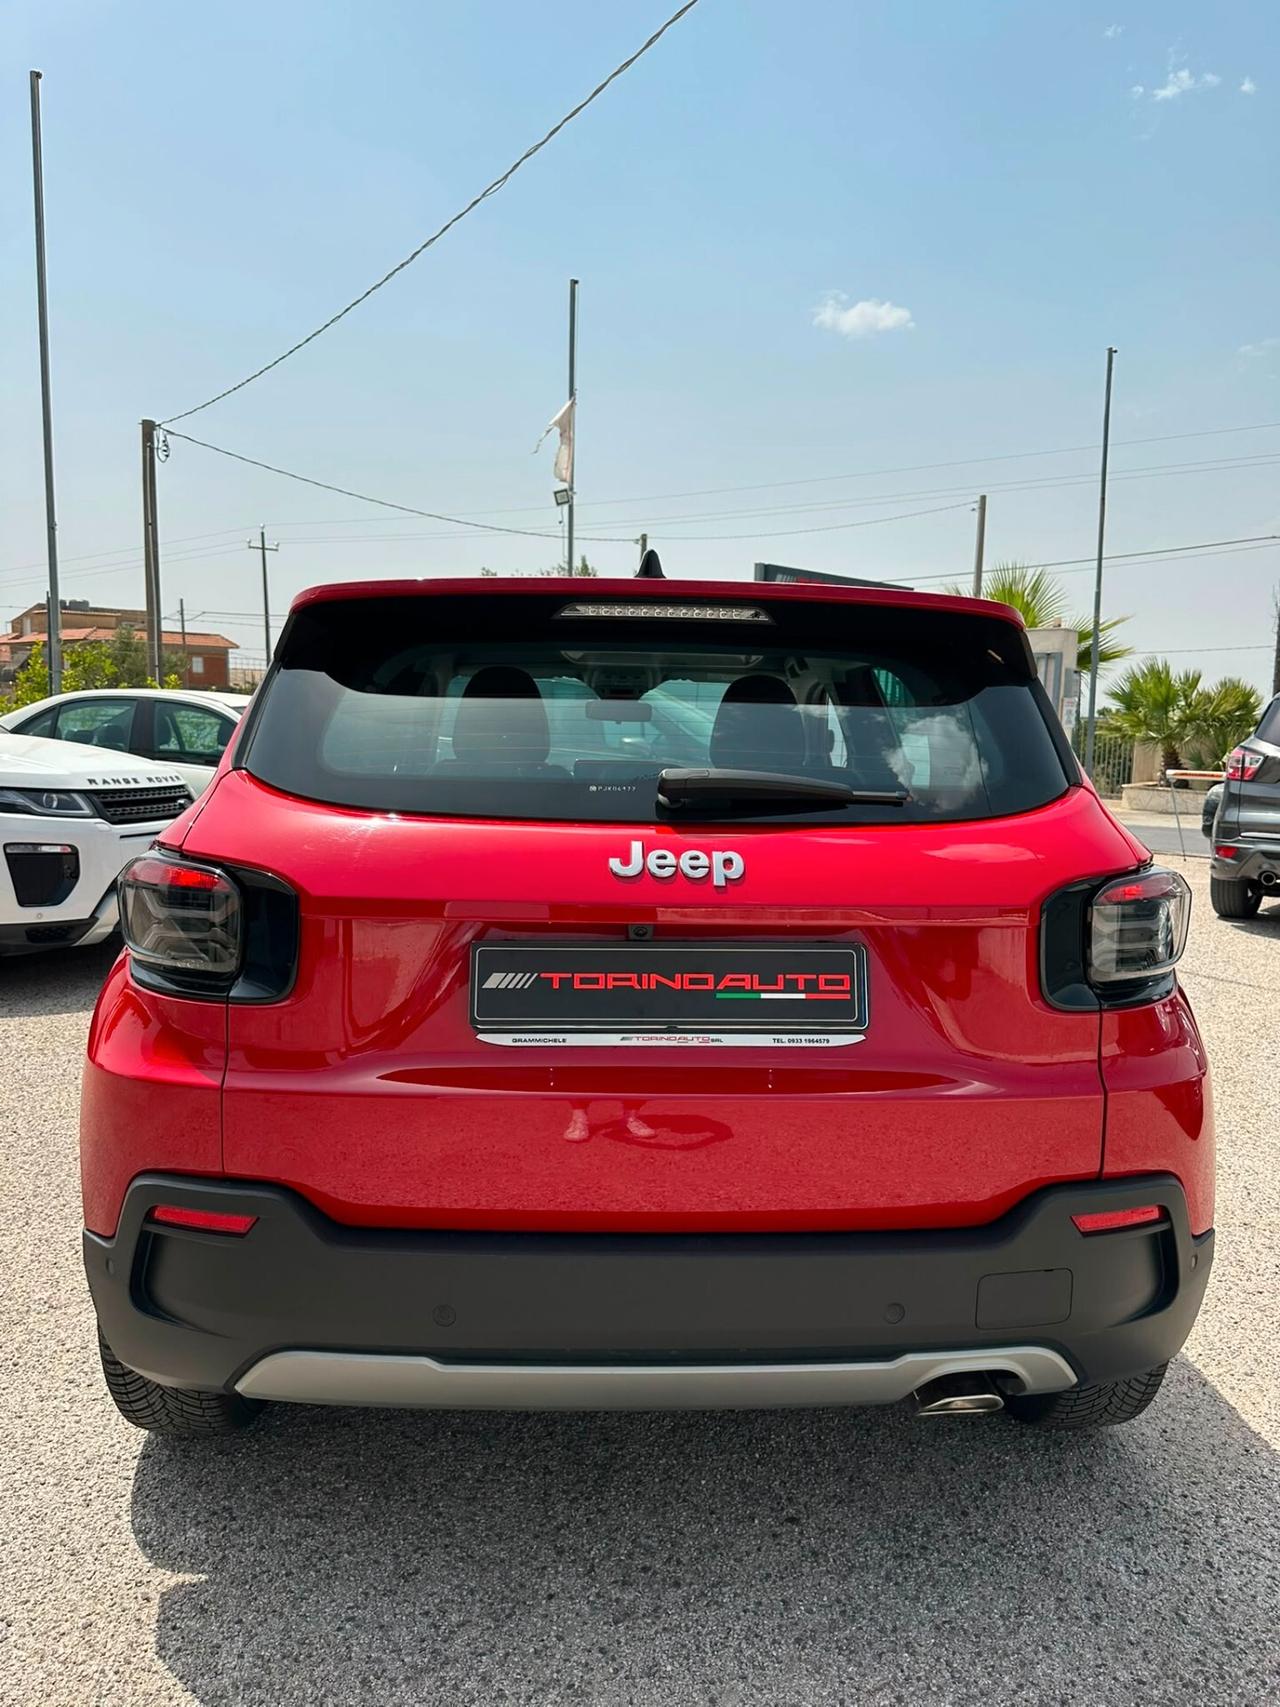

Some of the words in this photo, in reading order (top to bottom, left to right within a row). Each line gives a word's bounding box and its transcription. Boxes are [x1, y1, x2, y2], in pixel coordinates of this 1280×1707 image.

[87, 778, 141, 786] RANGE
[146, 775, 181, 784] ROVER
[609, 840, 745, 887] Jeep
[540, 972, 851, 991] TORINOAUTO
